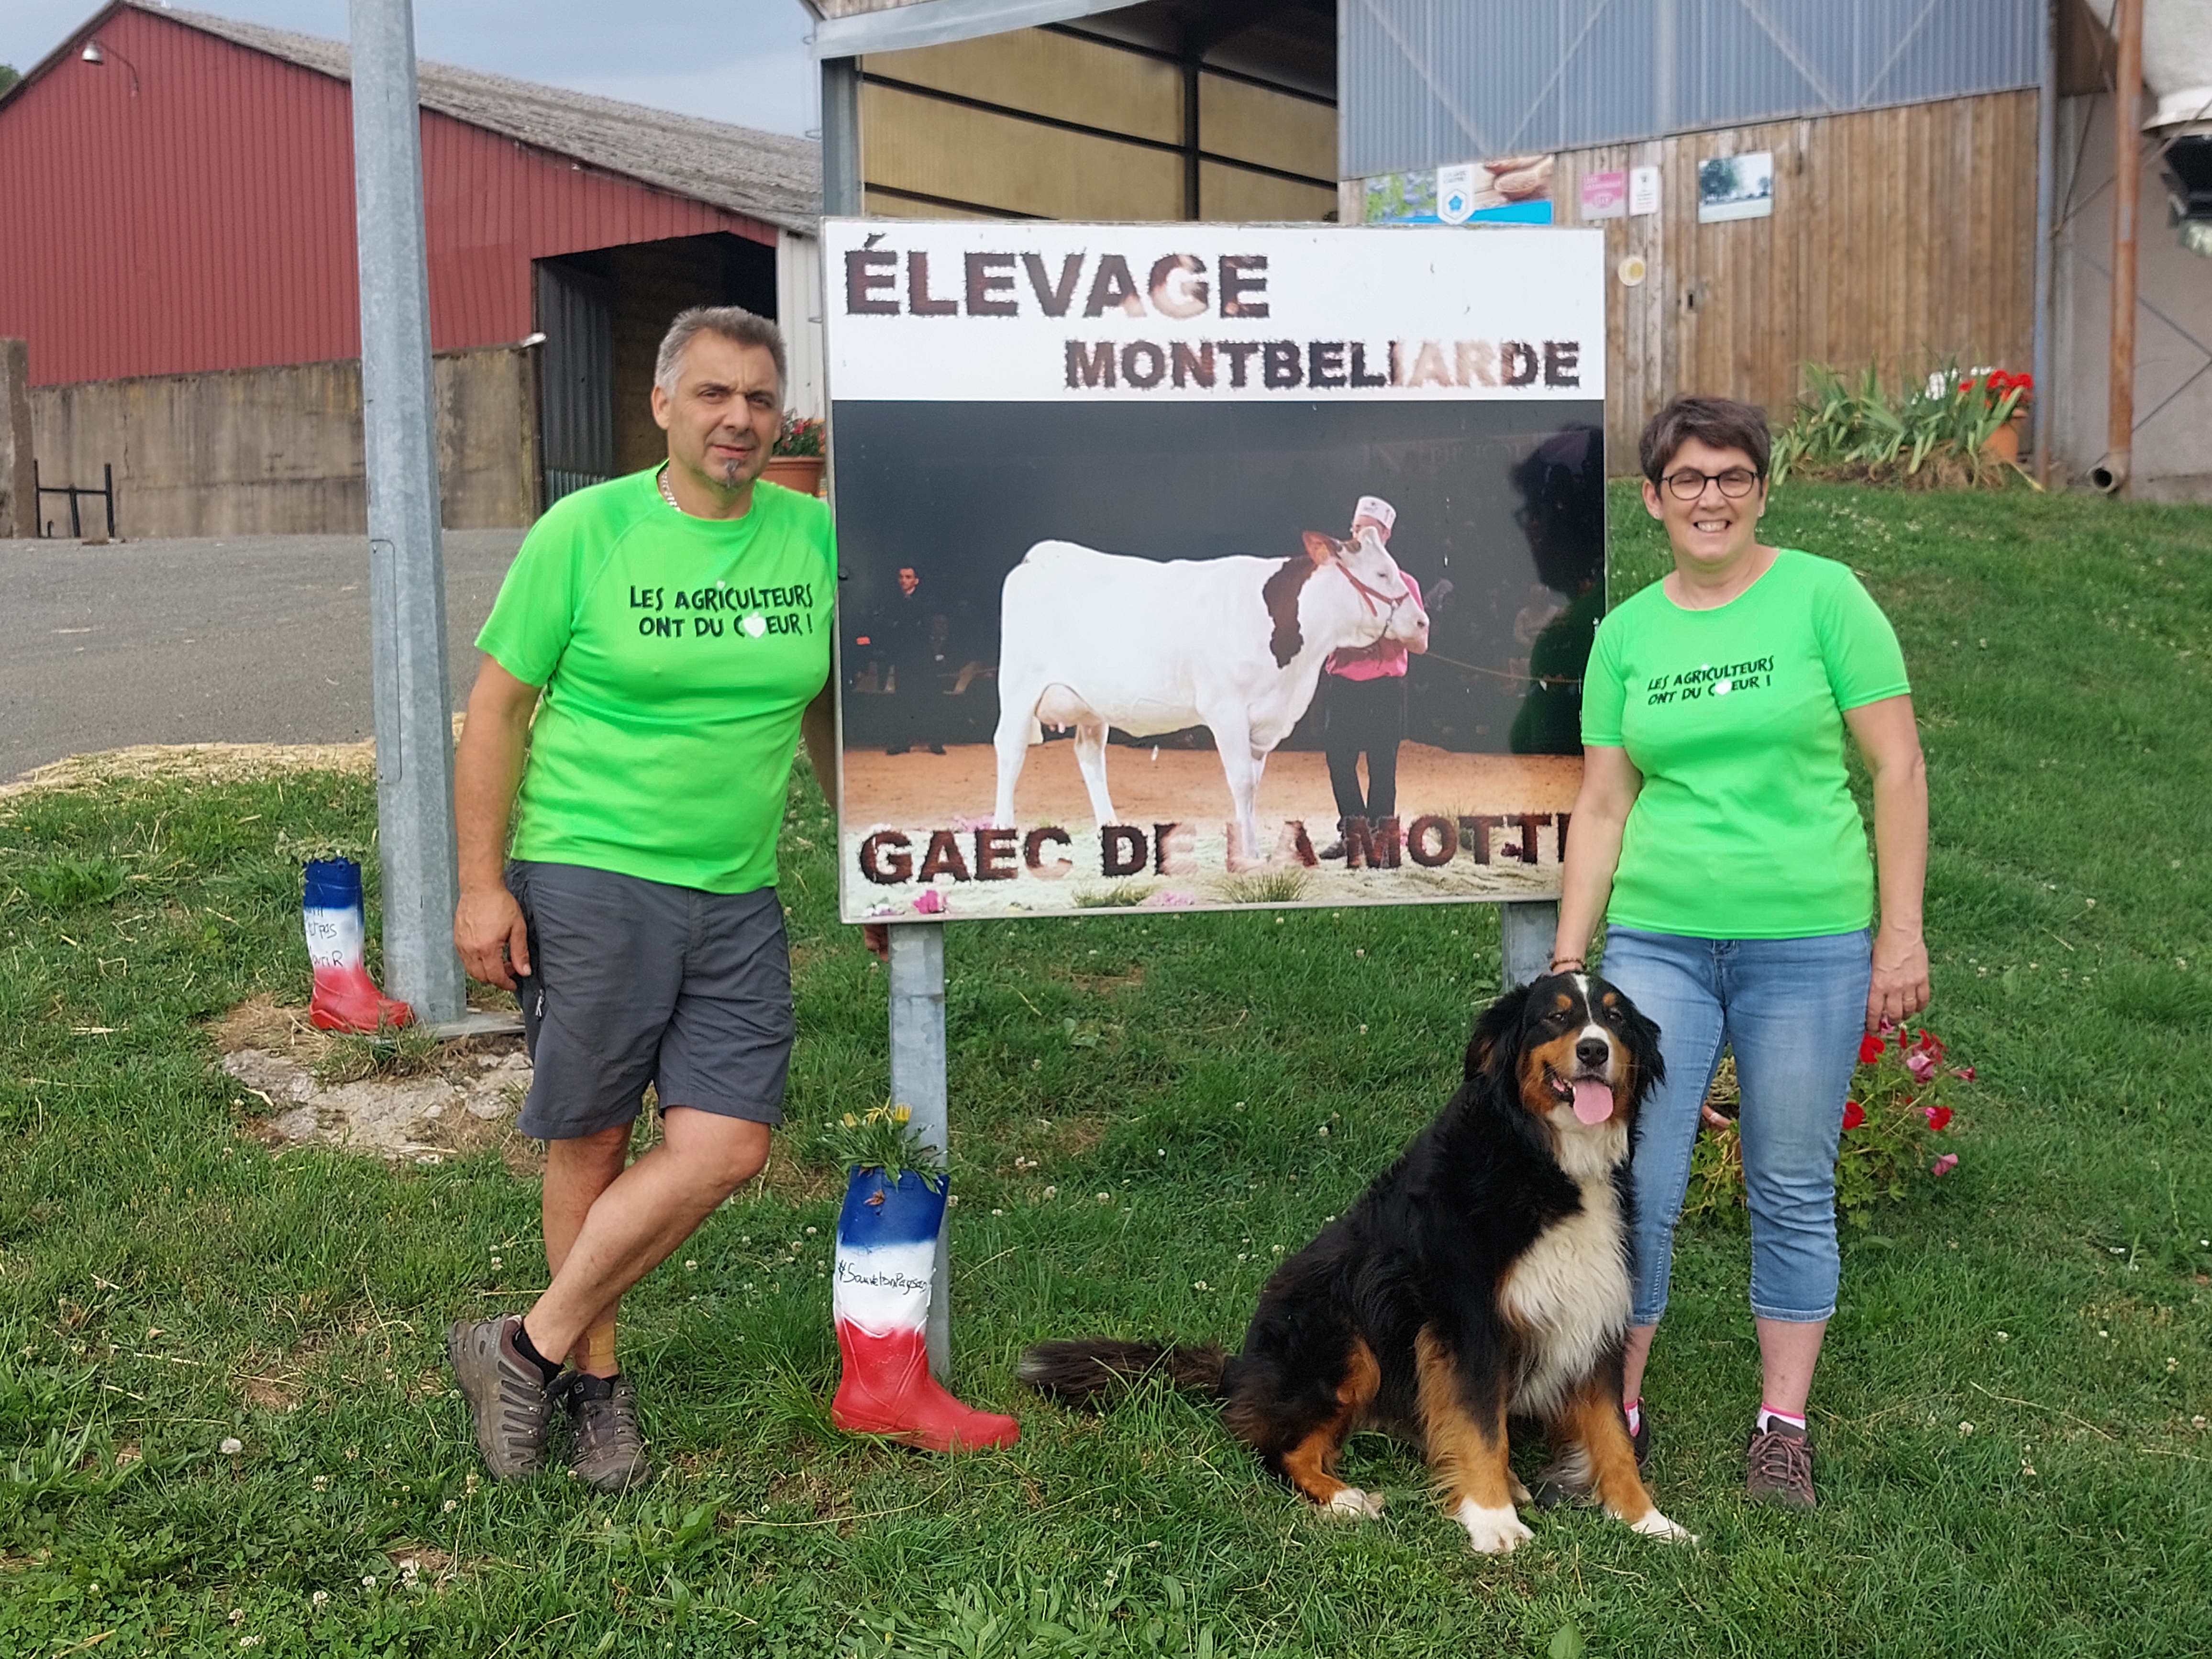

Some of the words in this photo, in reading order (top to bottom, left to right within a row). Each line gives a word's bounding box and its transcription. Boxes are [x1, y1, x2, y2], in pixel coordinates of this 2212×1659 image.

[844, 232, 1271, 319] ÉLEVAGE
[1064, 339, 1581, 388] MONTBELIARDE
[630, 585, 664, 612] LES
[675, 583, 813, 612] AGRICULTEURS
[639, 615, 686, 638] ONT
[695, 617, 724, 638] DU
[1647, 675, 1670, 692] LES
[1673, 655, 1774, 686] AGRICULTEURS
[1648, 691, 1677, 705] ONT
[1681, 687, 1702, 701] DU
[859, 824, 1073, 884] GAEC
[1101, 820, 1197, 878] DE
[1225, 818, 1319, 874] LA
